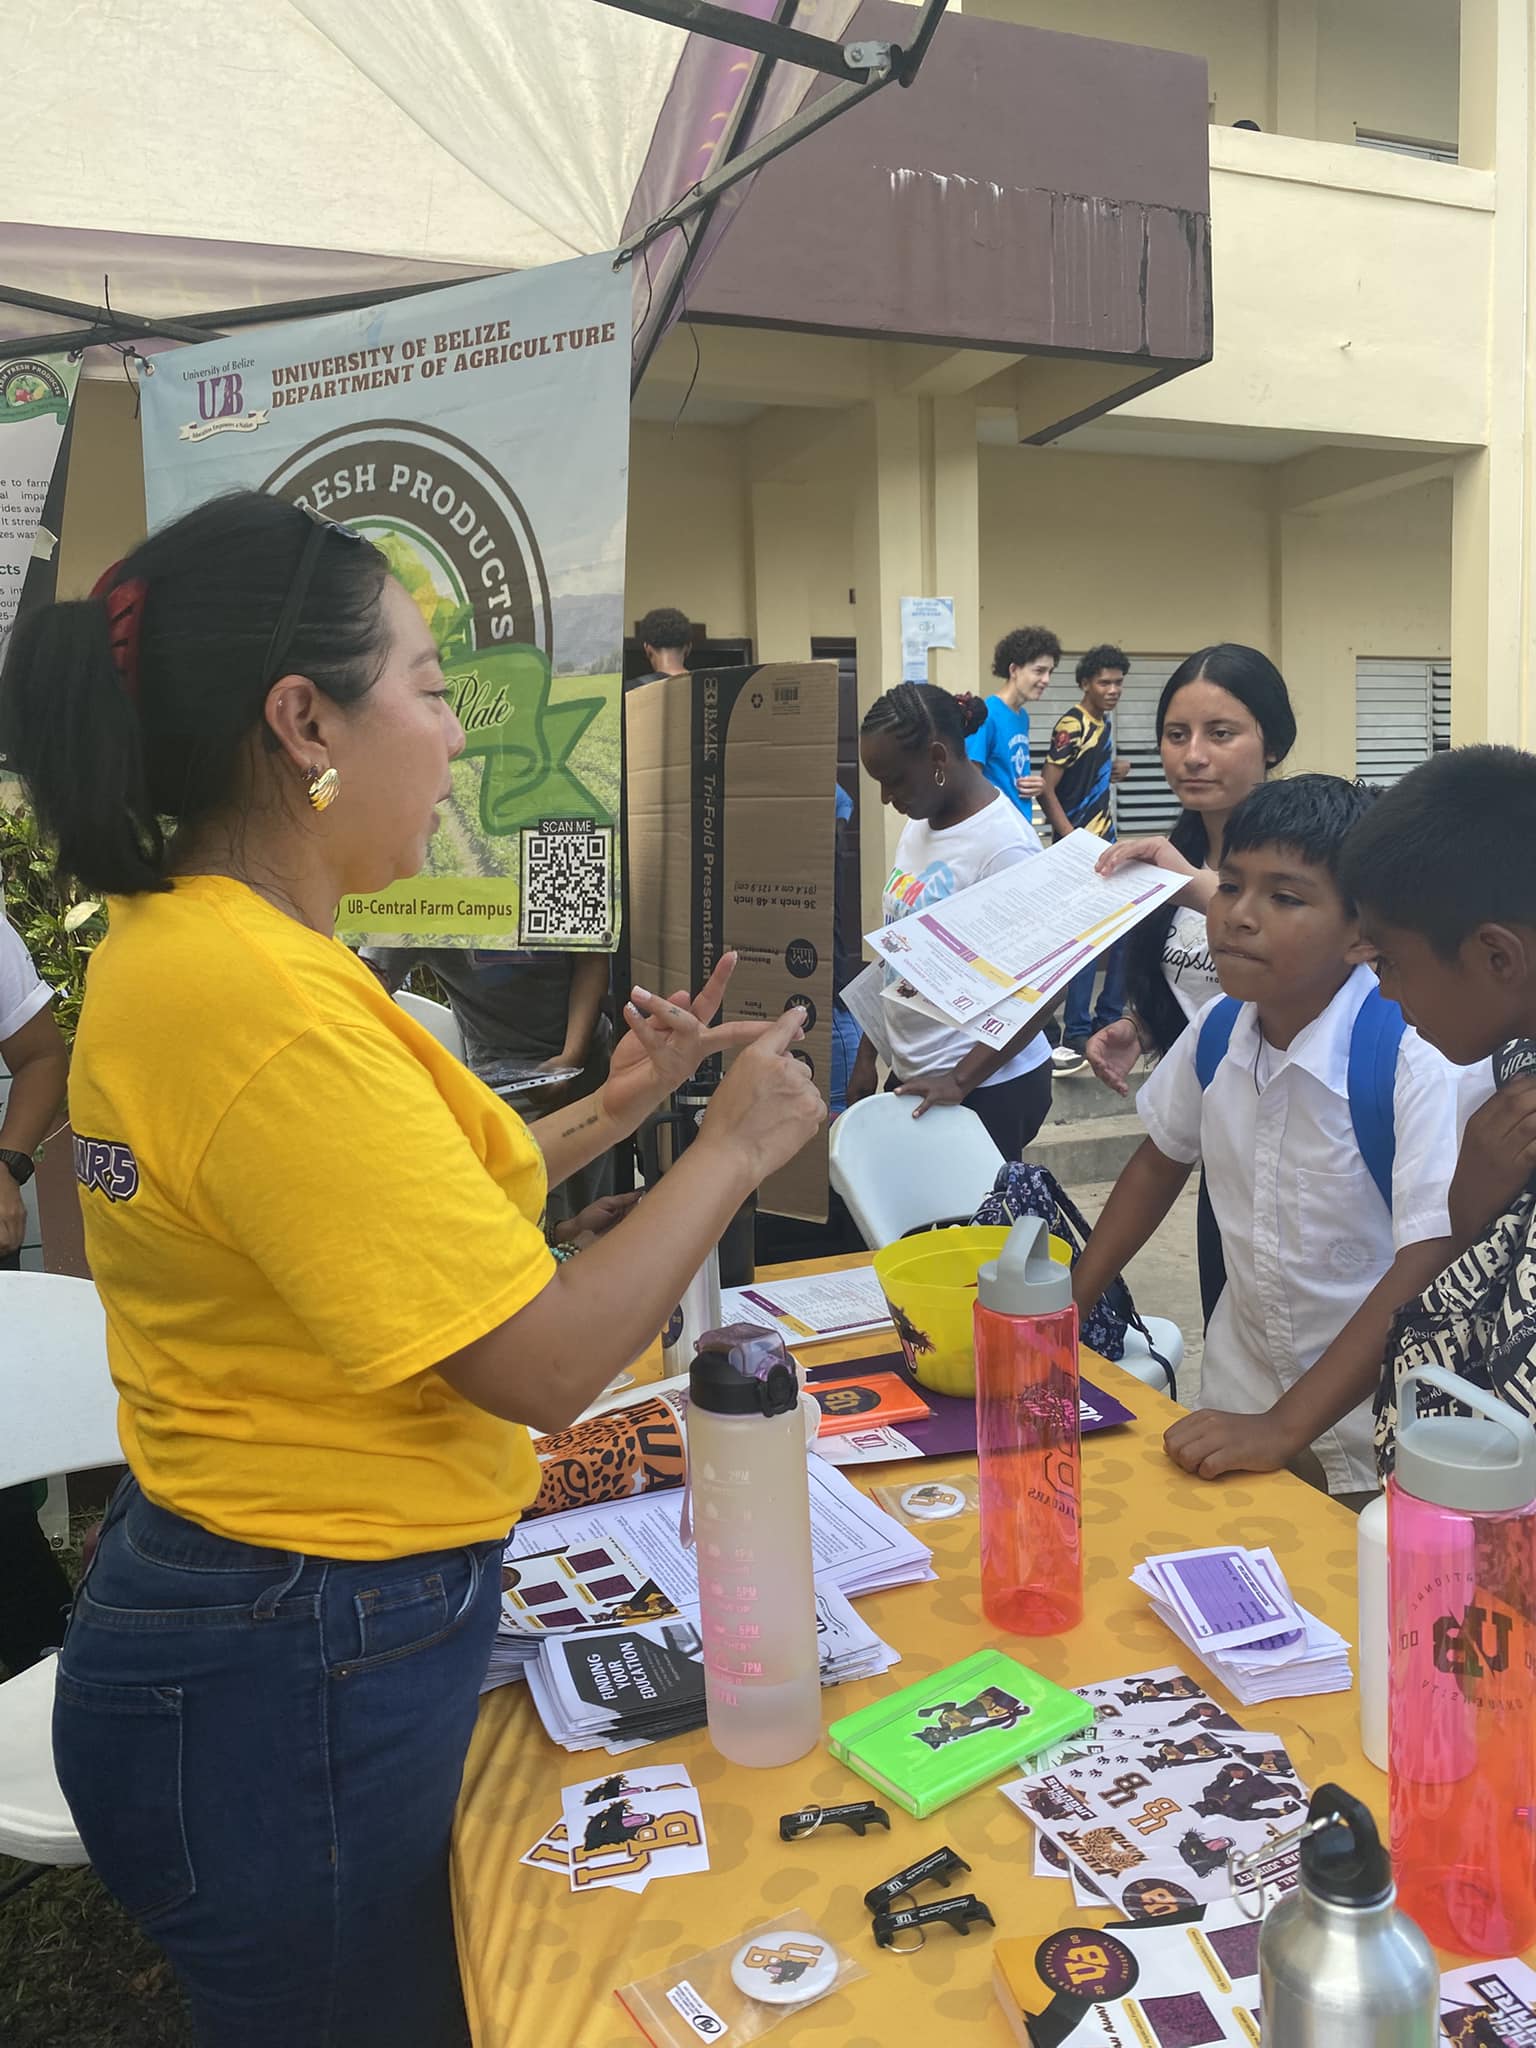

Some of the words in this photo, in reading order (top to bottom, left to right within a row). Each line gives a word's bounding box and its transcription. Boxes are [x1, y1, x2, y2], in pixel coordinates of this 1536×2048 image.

[182, 365, 220, 381] University
[222, 361, 230, 372] of
[232, 357, 255, 370] Belize
[271, 363, 415, 409] DEPARTMENT
[420, 356, 448, 379] OF
[453, 321, 616, 373] AGRICULTURE
[272, 344, 395, 387] UNIVERSITY
[401, 337, 427, 361] OF
[433, 319, 511, 354] BELIZE
[196, 373, 244, 421] UB
[11, 479, 22, 487] to
[390, 463, 514, 640] PRODUCTS
[707, 708, 719, 764] BAZIC
[542, 820, 573, 834] SCAN
[575, 819, 592, 833] ME
[703, 773, 717, 848] Tri-Fold
[348, 898, 417, 916] UB-Central
[420, 899, 454, 916] Farm
[456, 900, 513, 920] Campus
[702, 852, 715, 981] Presentation
[733, 895, 753, 905] inch
[757, 896, 768, 907] 48
[779, 898, 800, 909] inch
[805, 900, 817, 910] 36
[586, 1653, 618, 1702] FUNDING
[606, 1661, 626, 1693] YOUR
[619, 1640, 658, 1701] EDUCATION
[742, 1661, 763, 1674] 7PM
[1046, 1777, 1095, 1821] JAGUARS
[1097, 1772, 1153, 1809] UB
[1127, 1797, 1183, 1836] UB
[1064, 1944, 1111, 1985] UB
